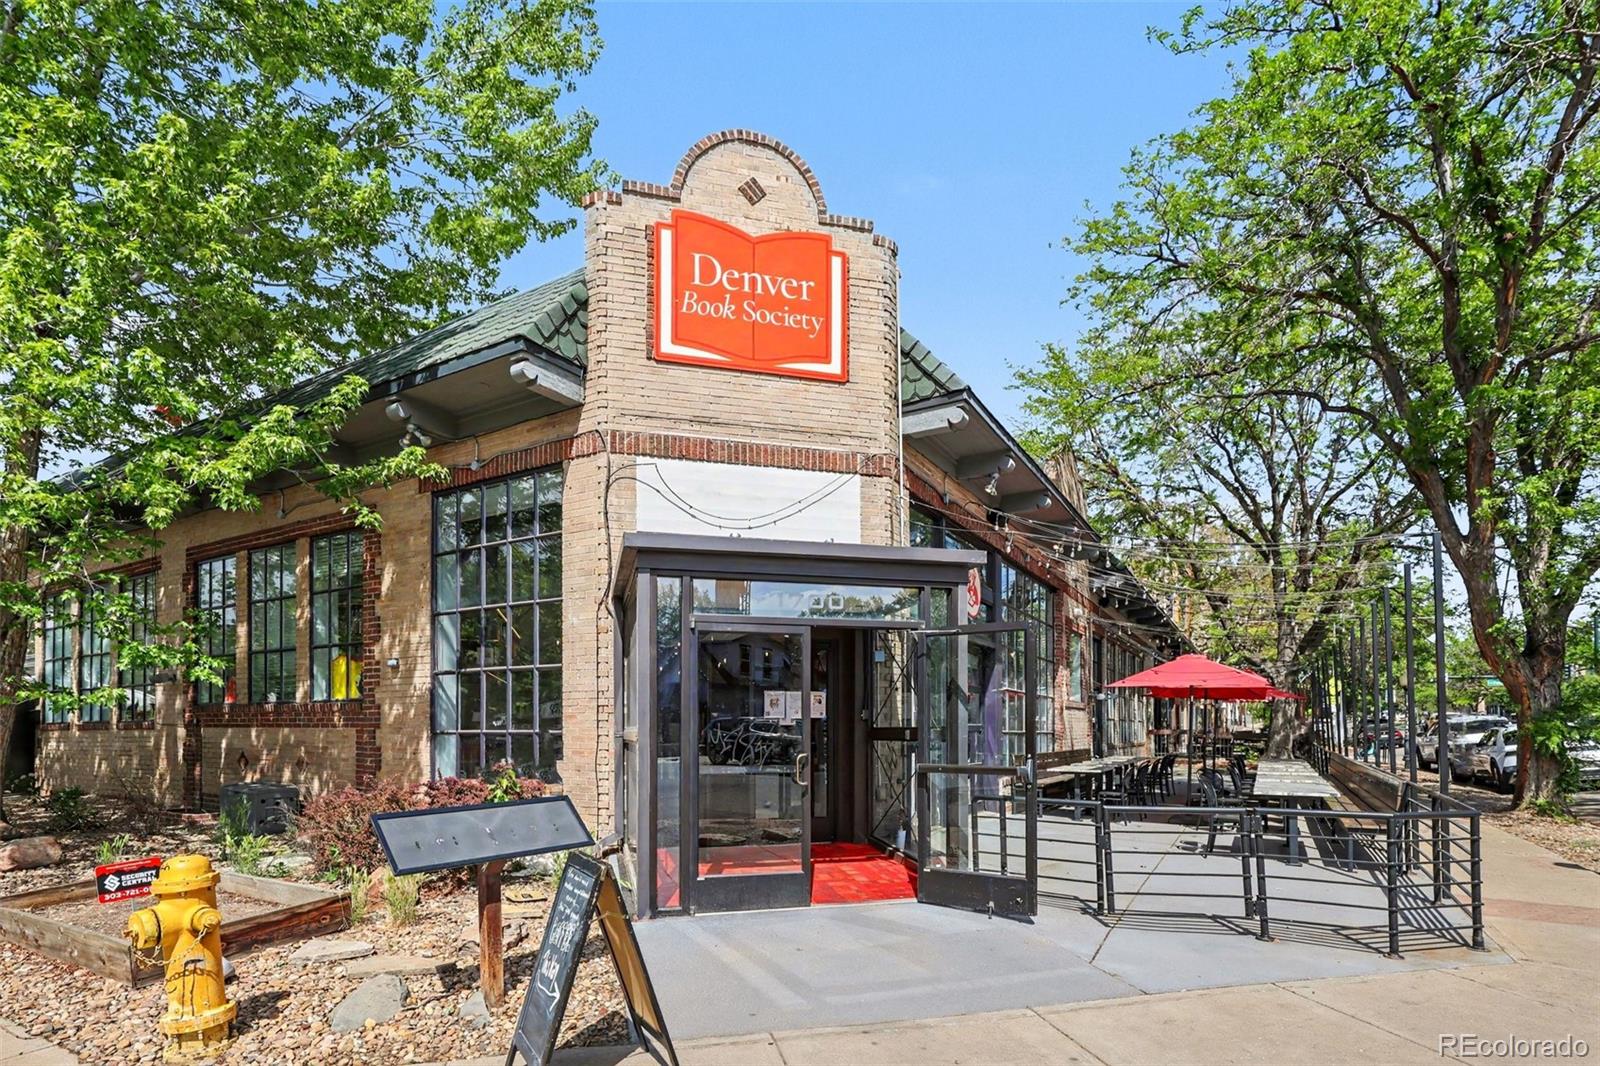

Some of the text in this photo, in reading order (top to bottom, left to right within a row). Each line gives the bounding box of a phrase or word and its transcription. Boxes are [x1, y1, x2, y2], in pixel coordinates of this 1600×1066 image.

[691, 252, 816, 301] Denver
[681, 290, 824, 338] Book Society
[121, 869, 157, 881] SECURITY
